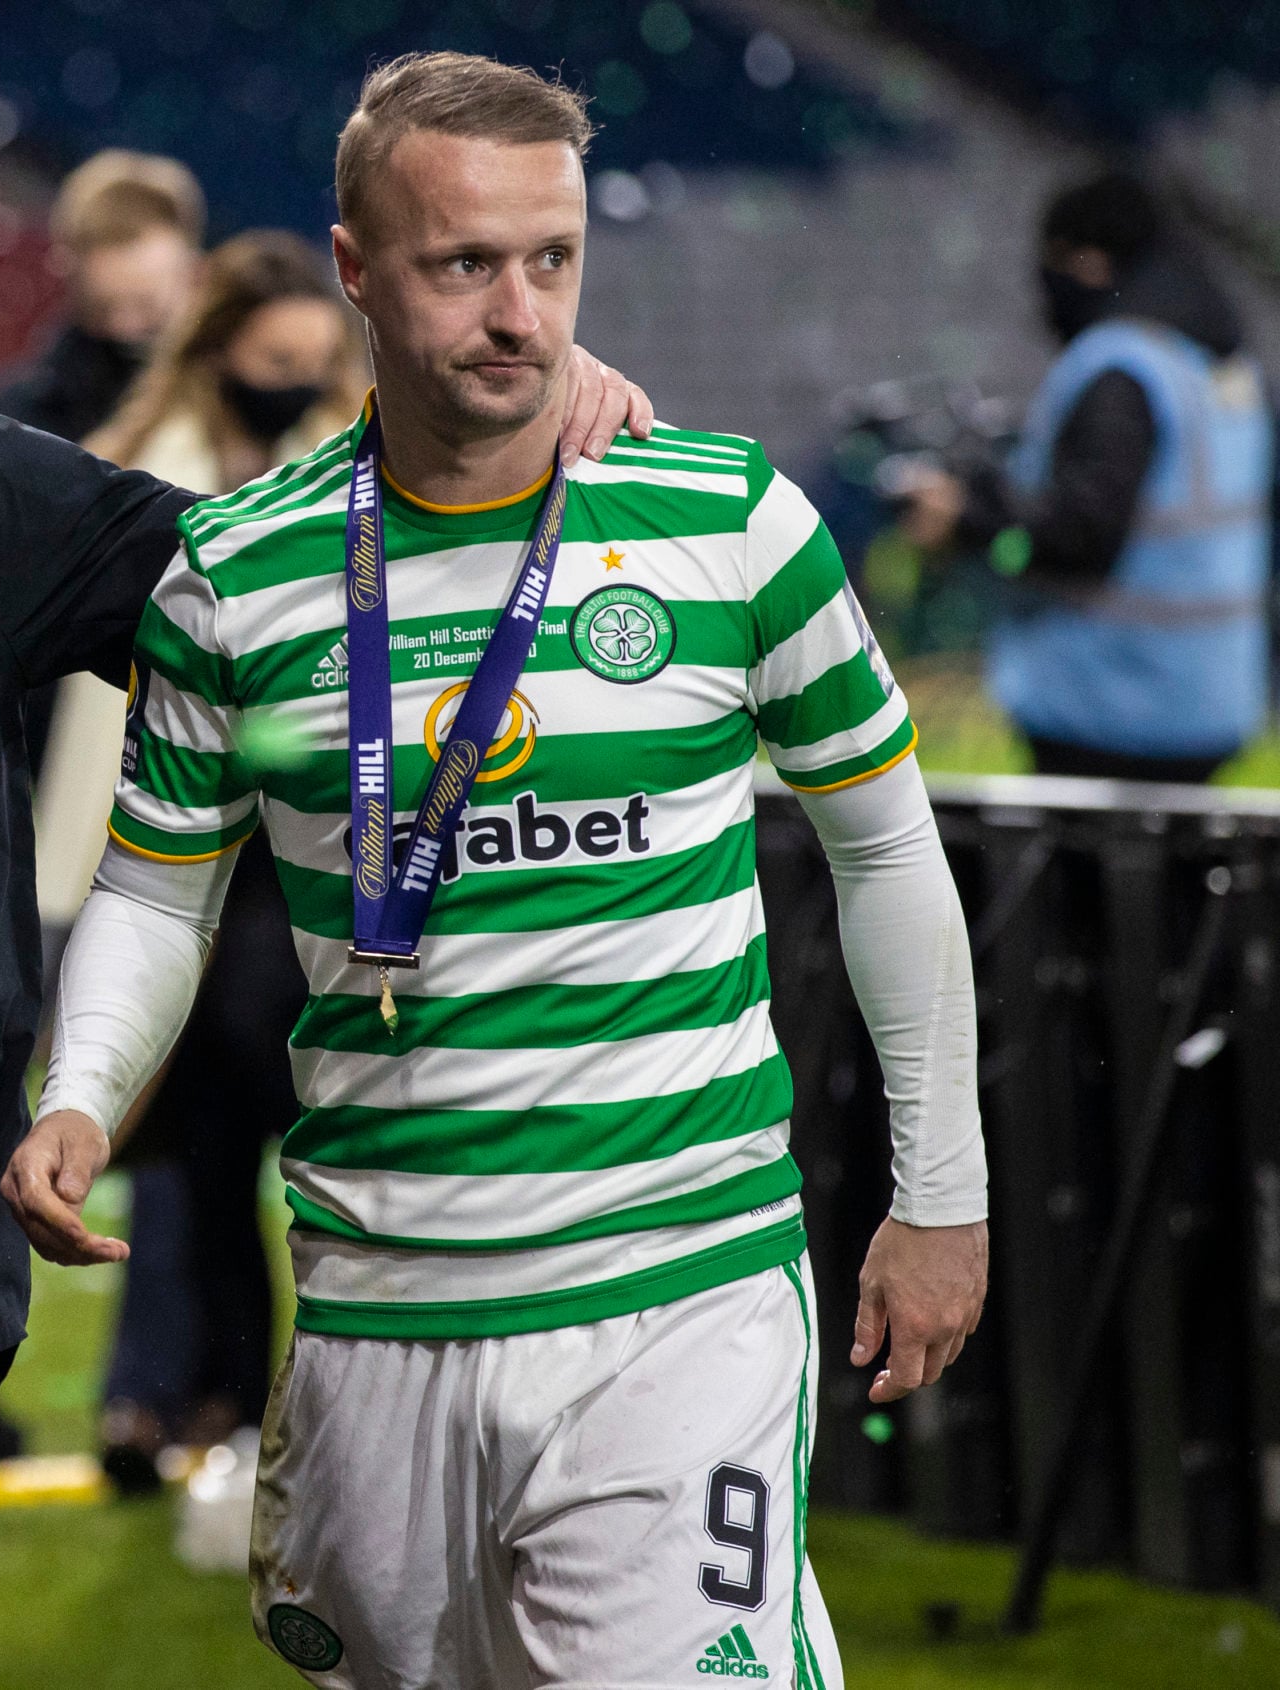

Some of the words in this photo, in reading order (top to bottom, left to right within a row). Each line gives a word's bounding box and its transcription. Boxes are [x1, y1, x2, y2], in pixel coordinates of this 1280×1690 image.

[354, 454, 375, 510] HILL
[536, 474, 566, 572] William
[350, 511, 382, 612] William
[511, 566, 547, 622] HILL
[575, 621, 587, 639] THE
[581, 595, 607, 620] CELTIC
[607, 591, 654, 611] FOOTBALL
[653, 609, 669, 634] CLUB
[413, 652, 431, 669] 20
[429, 629, 450, 646] Hill
[453, 626, 496, 643] Scotti
[537, 619, 567, 636] Final
[311, 666, 349, 688] adi
[616, 668, 639, 678] 1888
[122, 756, 136, 773] CUP
[358, 738, 385, 794] HILL
[422, 740, 478, 840] William
[357, 795, 389, 900] William
[401, 836, 442, 892] HILL
[698, 1461, 771, 1613] 9
[696, 1656, 769, 1680] adidas
